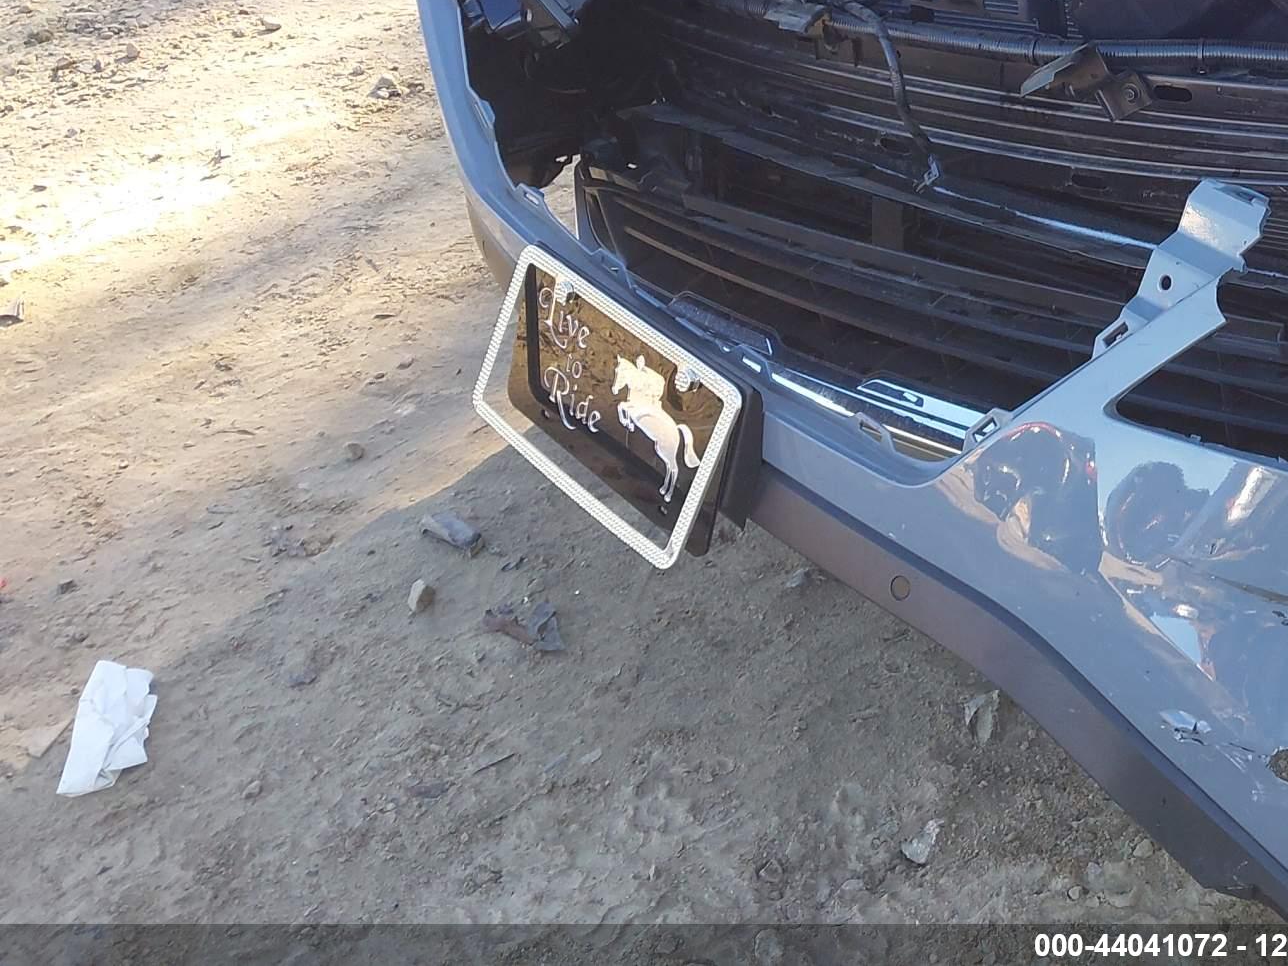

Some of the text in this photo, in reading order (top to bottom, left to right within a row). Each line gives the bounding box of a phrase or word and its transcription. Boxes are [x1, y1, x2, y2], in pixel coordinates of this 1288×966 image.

[538, 286, 590, 350] Live
[566, 353, 583, 379] to
[543, 366, 601, 433] Ride
